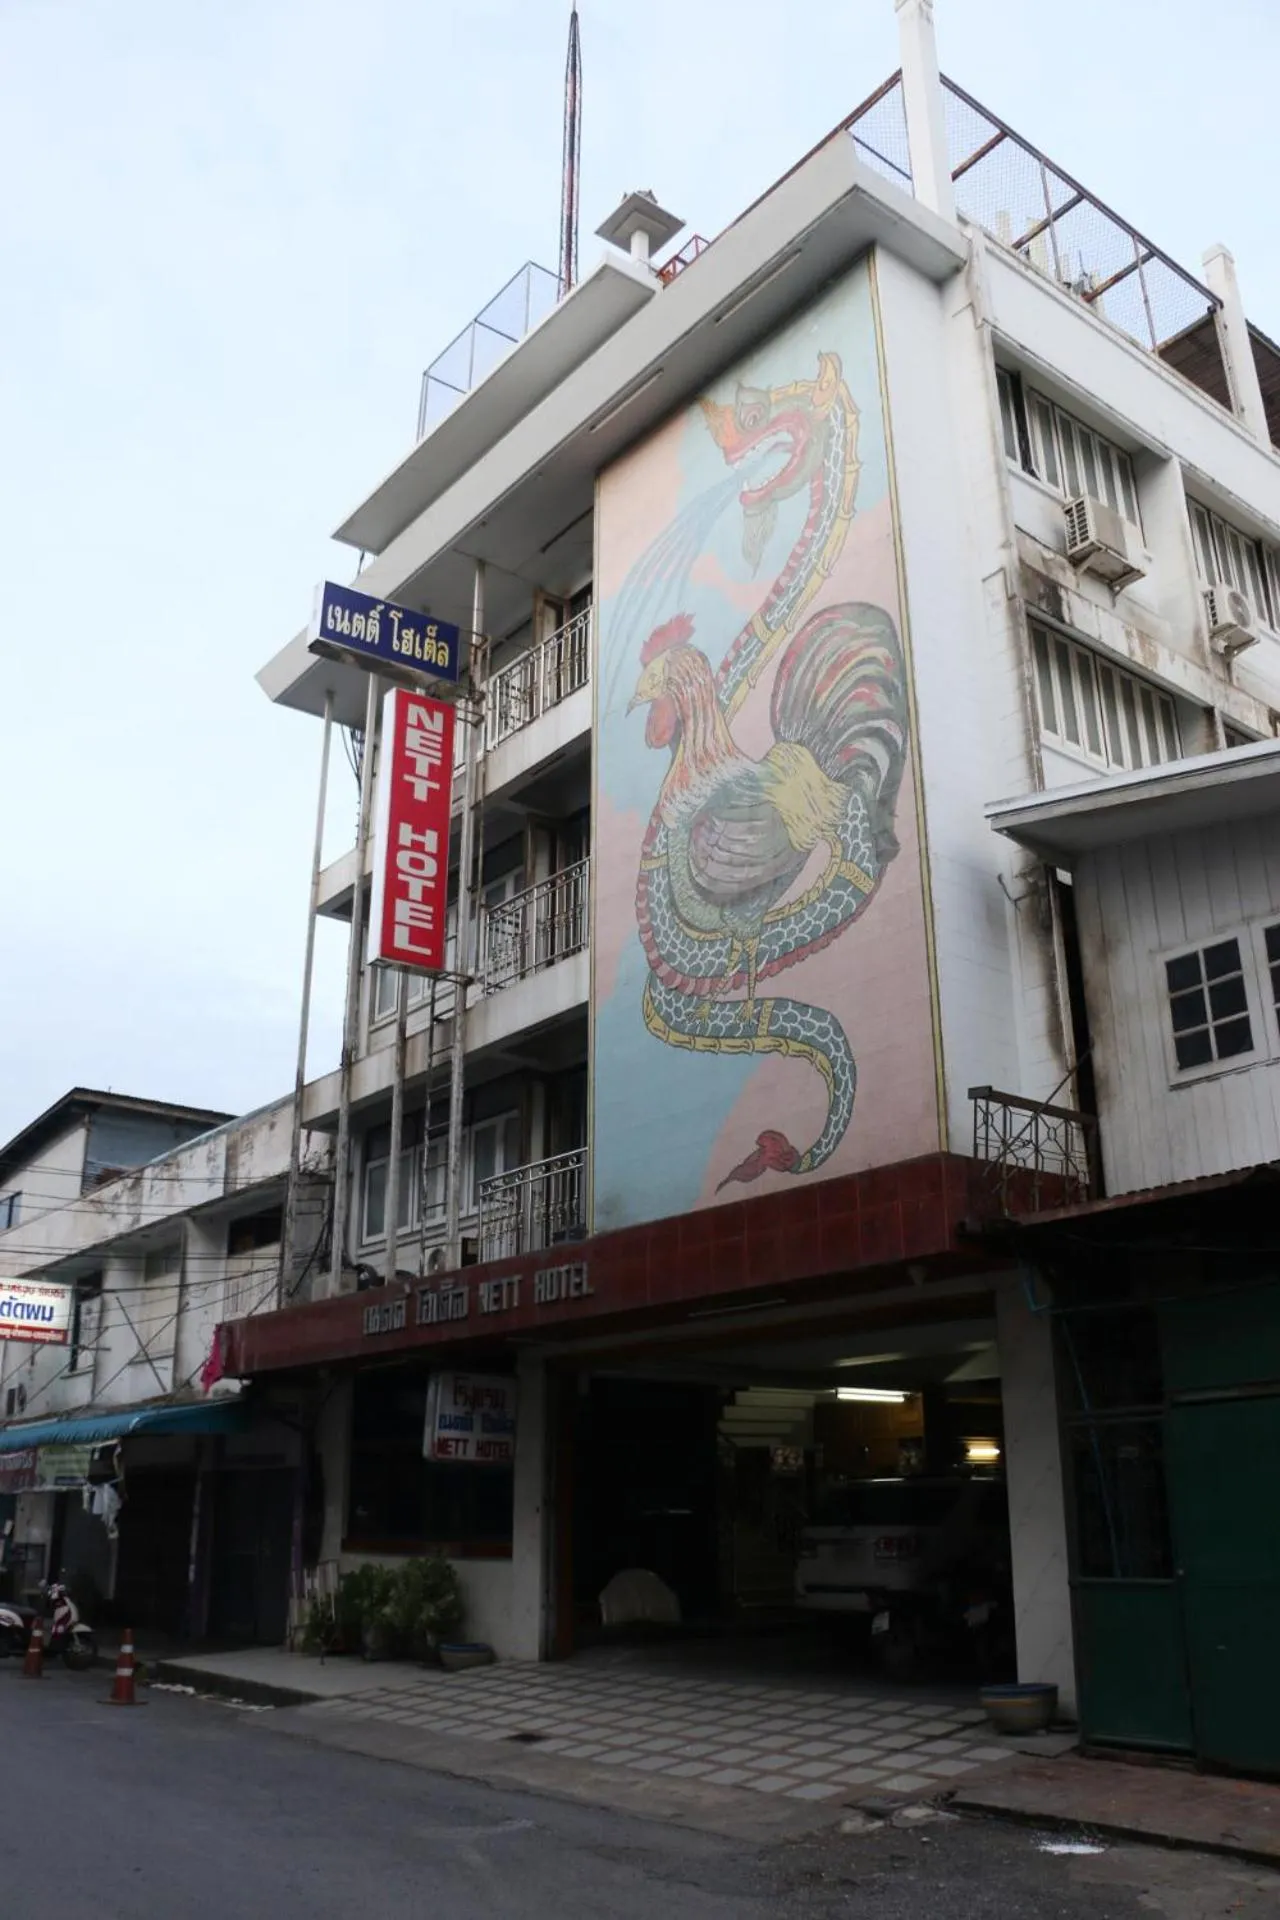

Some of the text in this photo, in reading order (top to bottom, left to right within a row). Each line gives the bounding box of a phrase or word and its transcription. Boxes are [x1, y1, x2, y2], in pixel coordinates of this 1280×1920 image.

[388, 610, 450, 668] โฮเต็ล
[393, 703, 443, 955] NETT HOTEL
[478, 1262, 595, 1314] NETT HOTEL
[437, 1437, 469, 1456] NETT
